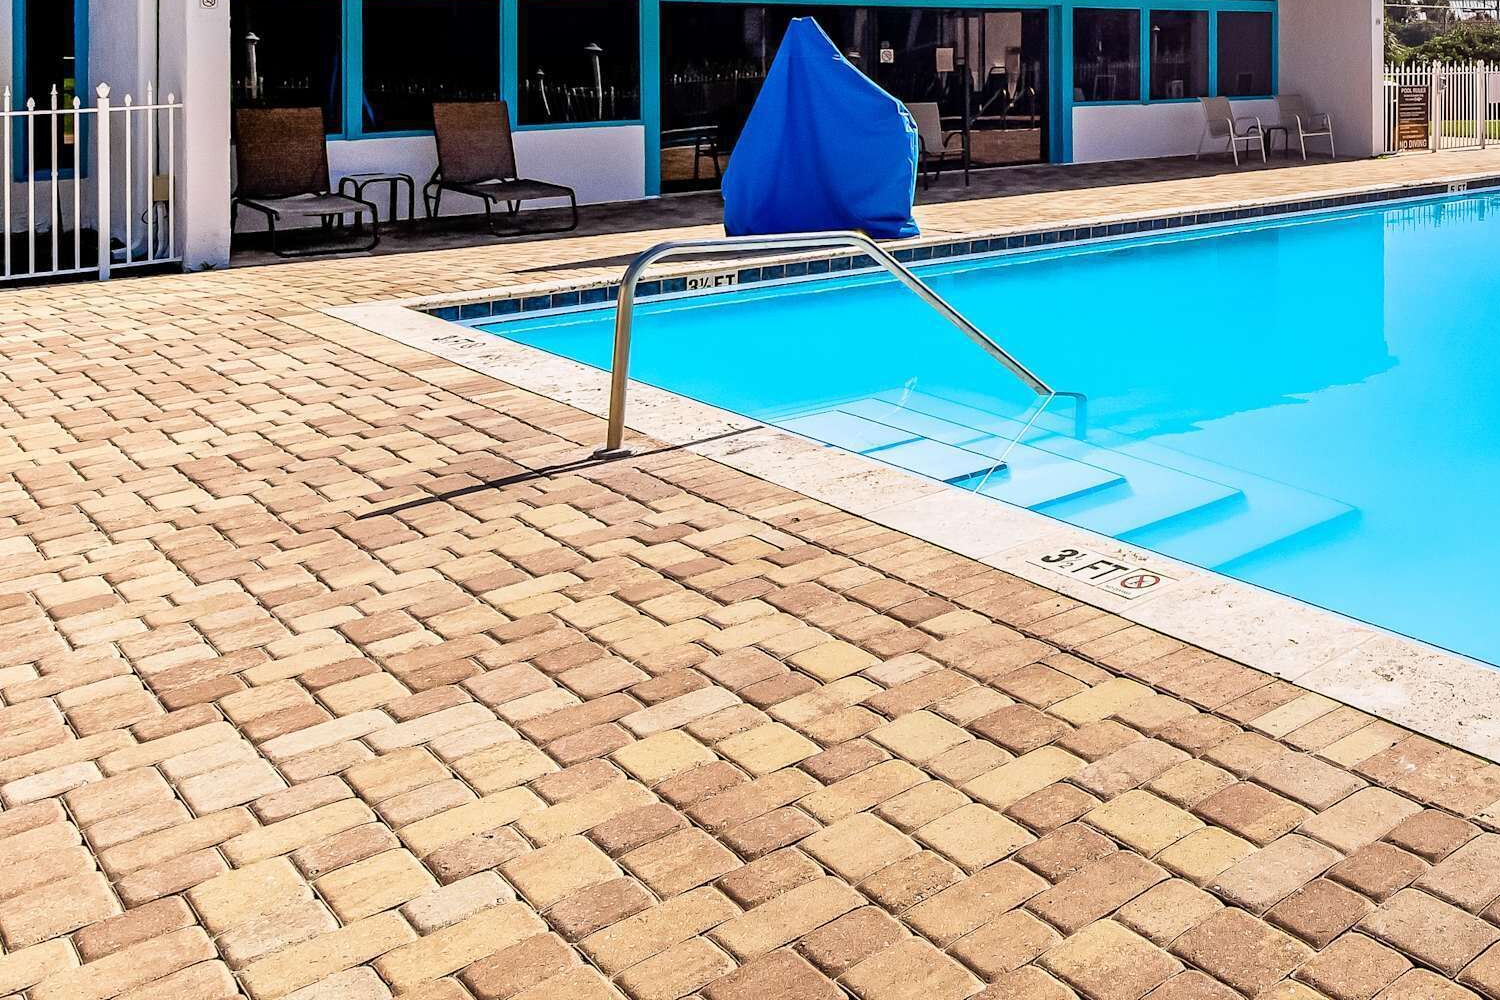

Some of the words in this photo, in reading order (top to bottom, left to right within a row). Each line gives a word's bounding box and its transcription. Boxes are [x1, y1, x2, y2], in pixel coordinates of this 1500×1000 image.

[1400, 140, 1408, 149] NO
[1409, 139, 1427, 149] DIVING
[714, 273, 736, 288] FT
[1071, 560, 1129, 580] FT
